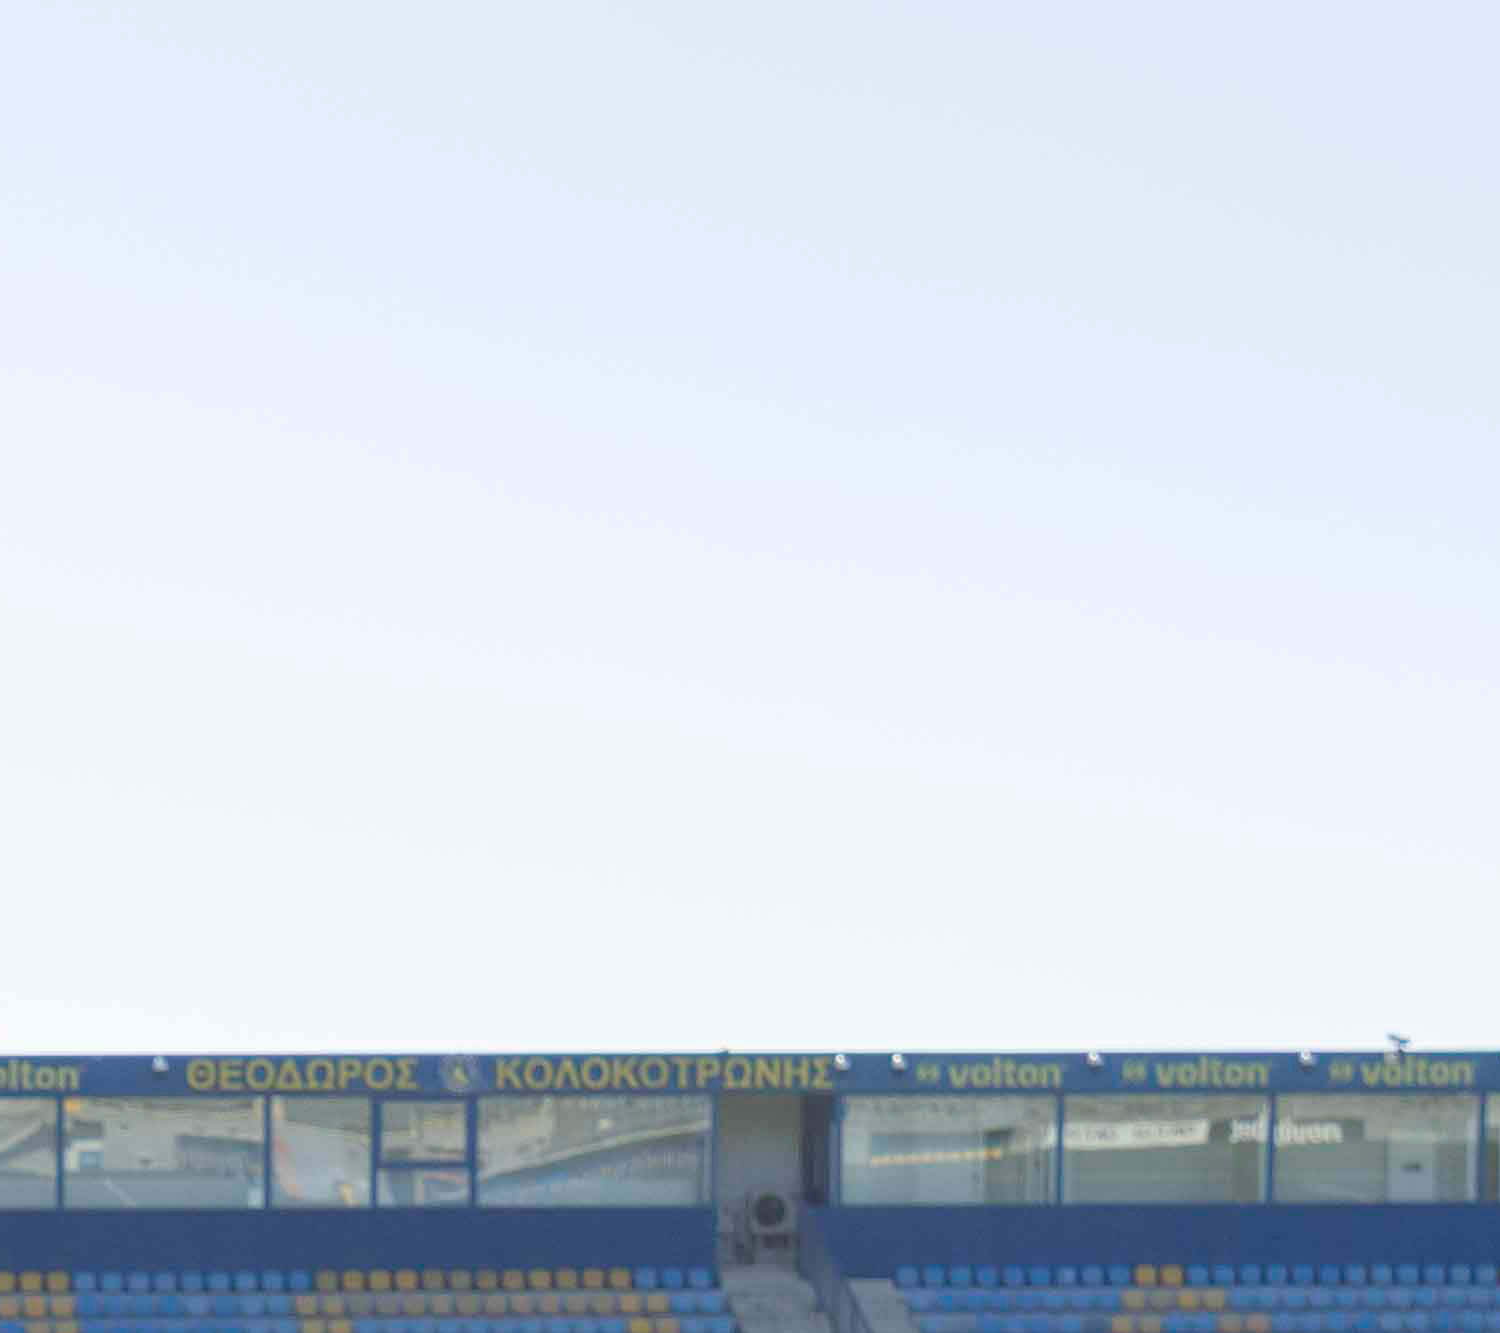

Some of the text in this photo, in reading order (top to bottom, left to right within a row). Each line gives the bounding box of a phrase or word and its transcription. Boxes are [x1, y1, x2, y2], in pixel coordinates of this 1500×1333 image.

[187, 1055, 834, 1092] ΘΕΟΔΩΡΟΣ ΚΟΛΟΚΟΤΡΩΝΗΣ
[950, 1060, 1062, 1088] volton
[1156, 1056, 1269, 1087] volton
[1364, 1056, 1475, 1086] volton
